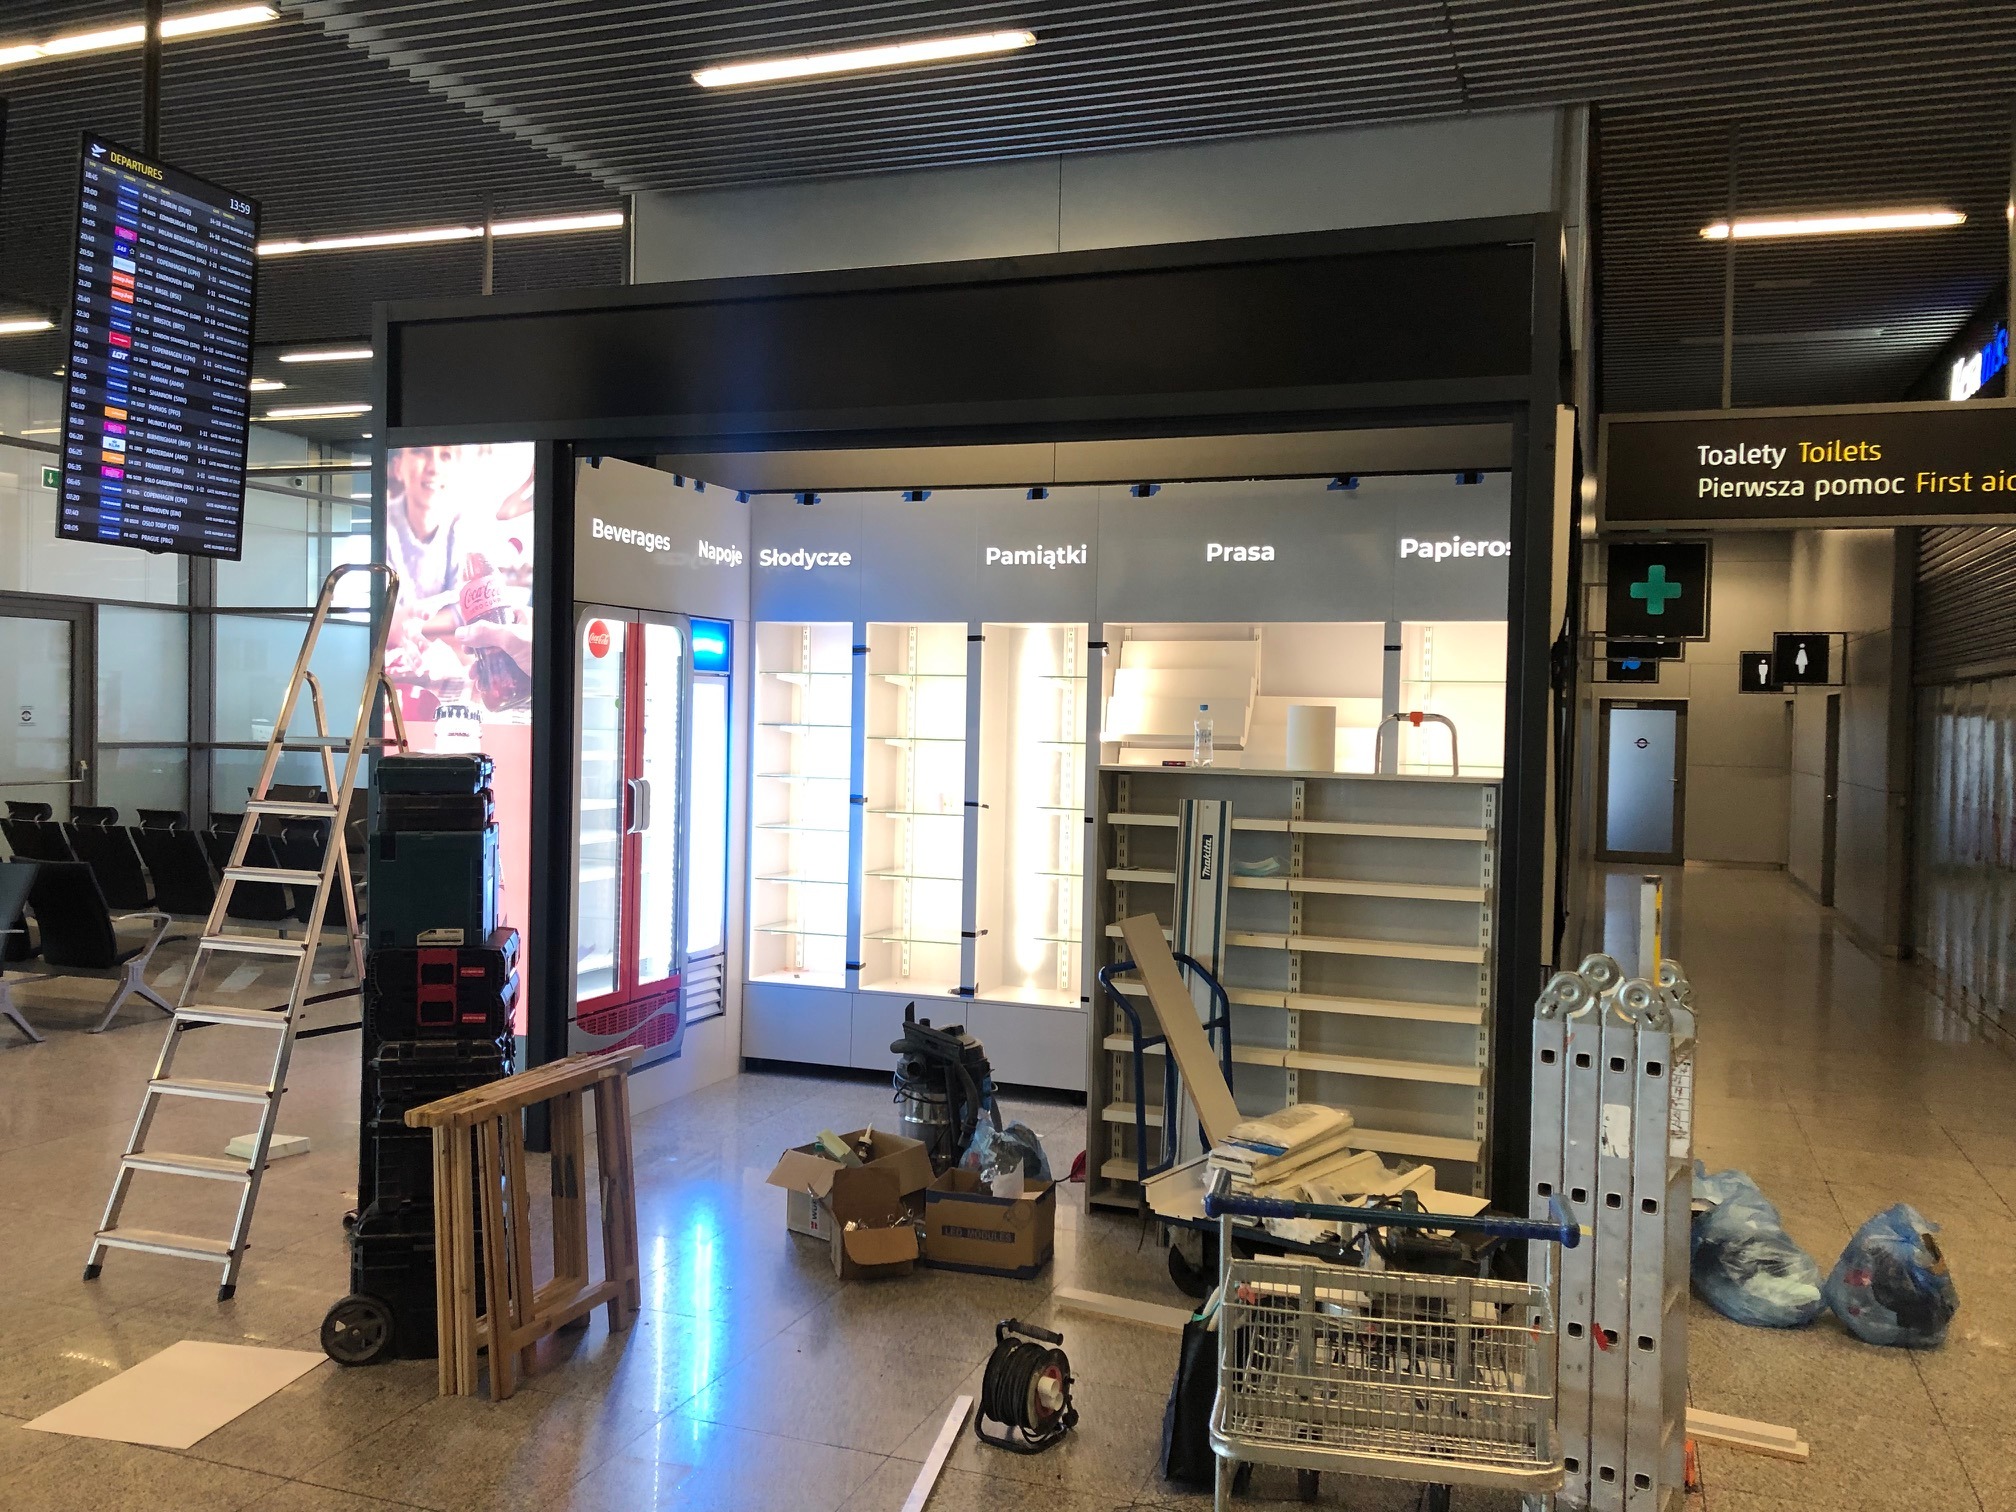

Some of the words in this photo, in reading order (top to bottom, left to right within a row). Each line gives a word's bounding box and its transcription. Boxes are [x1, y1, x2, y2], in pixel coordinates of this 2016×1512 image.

[110, 151, 163, 182] DEPARTURES
[230, 198, 251, 216] 13:59
[73, 355, 88, 366] 05:50
[112, 350, 128, 361] LOT
[72, 371, 87, 381] 06:05
[1697, 443, 1787, 470] Toalety
[1799, 440, 1882, 463] Toilets
[1699, 477, 1805, 498] Pierwsza
[1814, 476, 1906, 502] pomoc
[1916, 471, 1973, 494] First
[592, 517, 671, 553] Beverages
[698, 540, 743, 568] Napoje
[759, 548, 852, 571] Słodycze
[985, 543, 1088, 570] Pamiątki
[1206, 543, 1276, 562] Prasa
[944, 1226, 963, 1237] LED
[966, 1229, 1012, 1243] MODULES
